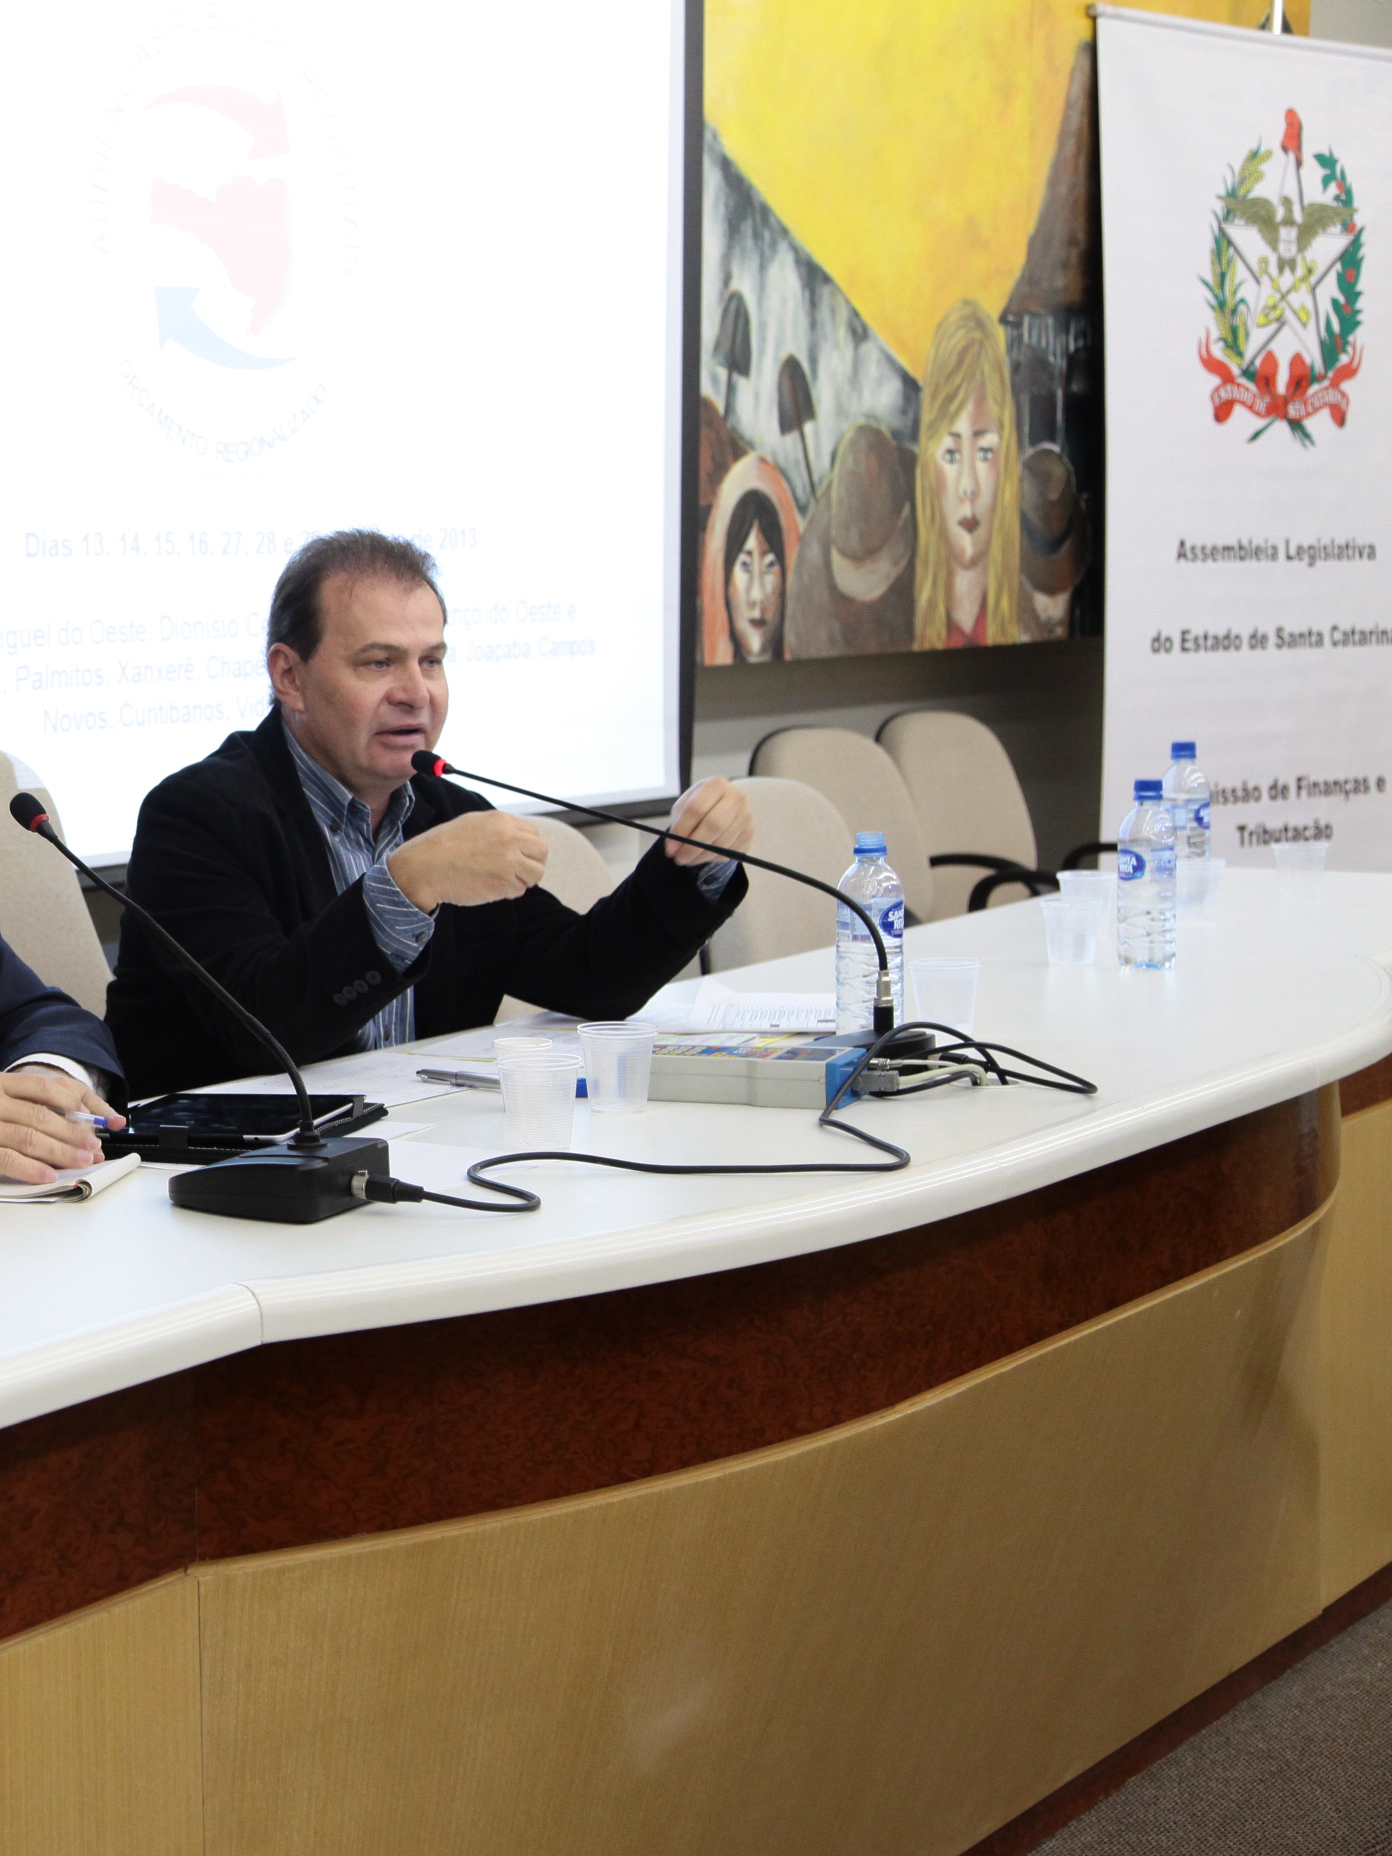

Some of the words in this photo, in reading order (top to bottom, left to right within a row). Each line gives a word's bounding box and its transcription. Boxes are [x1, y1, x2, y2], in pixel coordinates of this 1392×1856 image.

[25, 532, 72, 558] Dias
[256, 531, 277, 555] 28
[283, 536, 295, 555] e
[439, 527, 478, 551] 2013
[1176, 538, 1279, 562] Assembleia
[1285, 537, 1377, 567] Legislativa
[489, 600, 509, 624] do
[515, 598, 563, 623] Oeste
[567, 601, 578, 620] e
[58, 620, 84, 646] do
[160, 612, 239, 642] Dionísio
[1151, 630, 1174, 653] do
[1180, 628, 1243, 652] Estado
[1249, 627, 1269, 651] de
[1275, 626, 1325, 649] Santa
[1330, 623, 1392, 647] Catarin
[538, 634, 598, 662] Campos
[15, 664, 110, 693] Palmitos,
[206, 655, 266, 684] Chape
[43, 707, 114, 734] Novos,
[120, 699, 229, 728] Curitibanos,
[236, 694, 269, 719] Vid
[1268, 777, 1290, 801] de
[1296, 774, 1371, 802] Finanças
[1376, 775, 1386, 793] e
